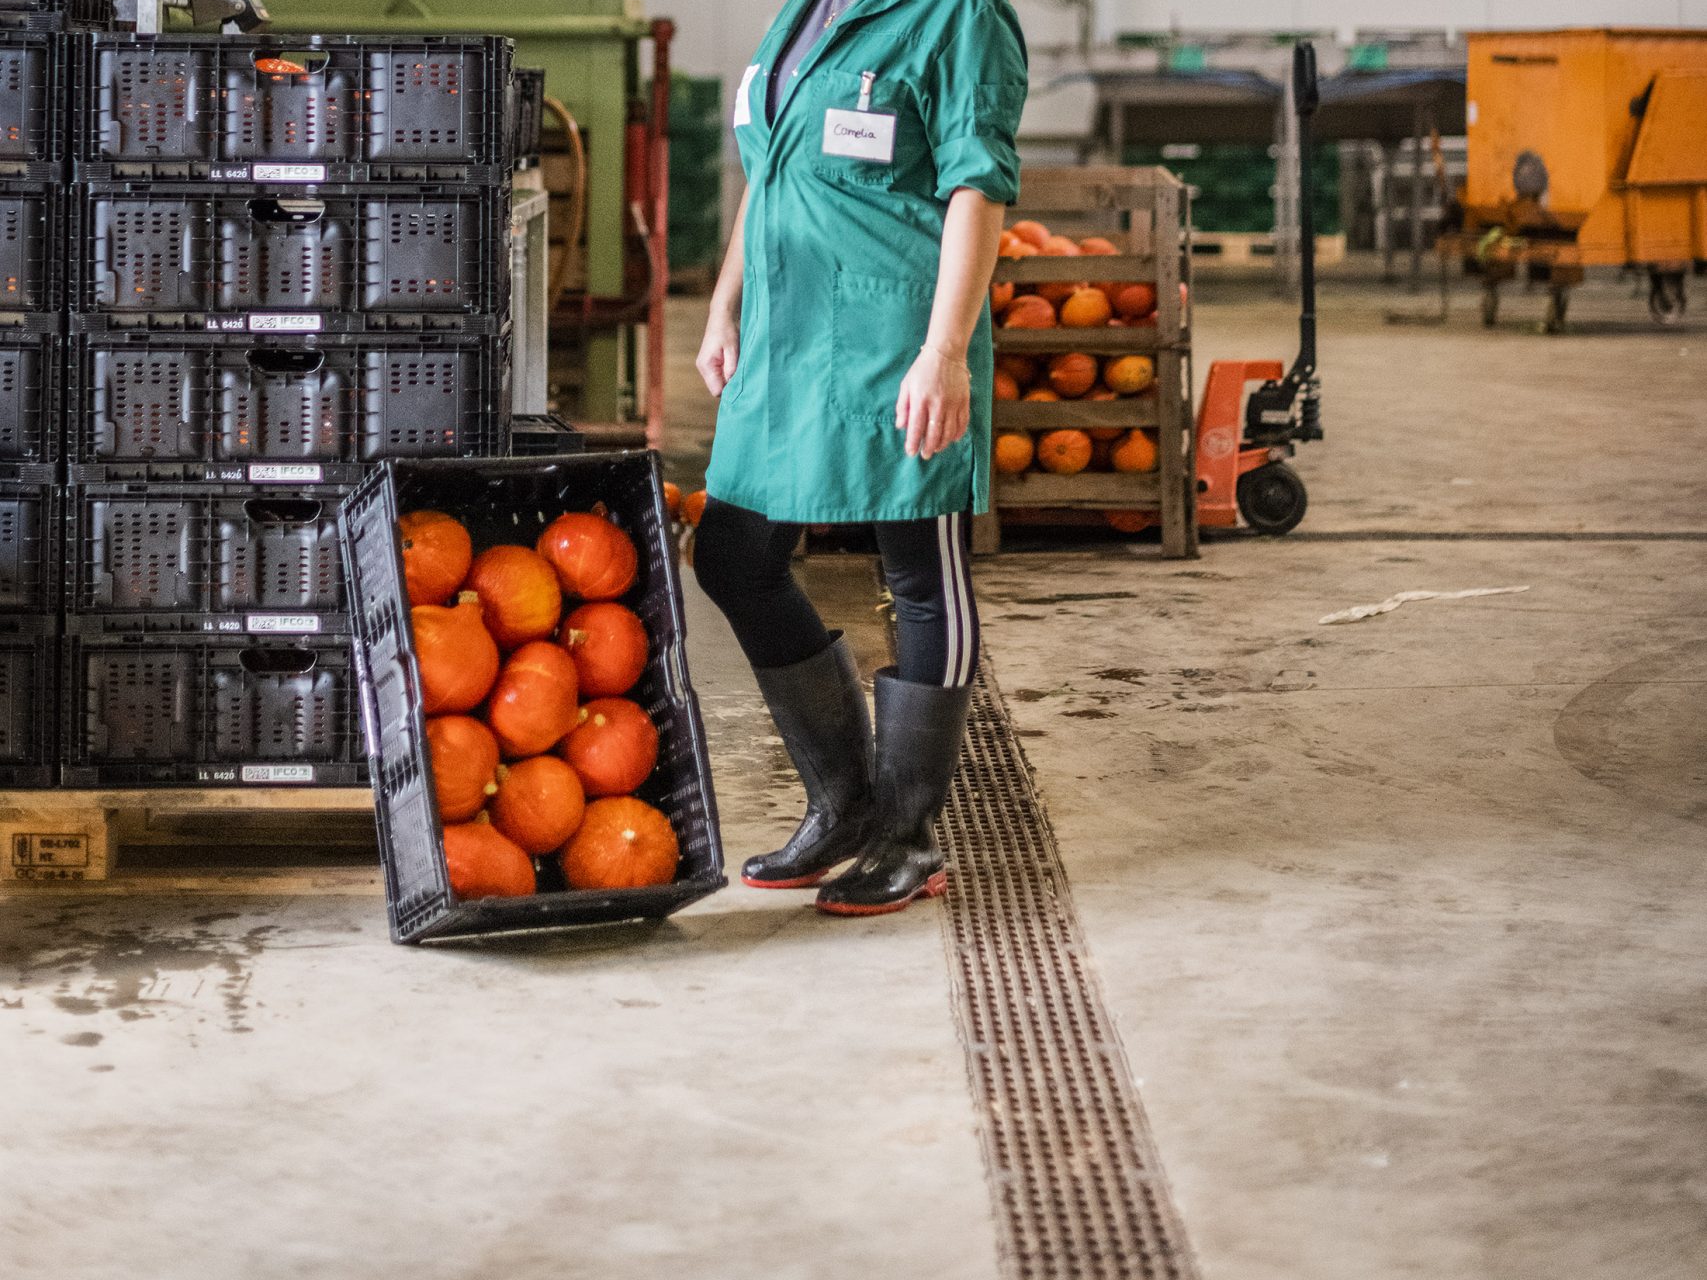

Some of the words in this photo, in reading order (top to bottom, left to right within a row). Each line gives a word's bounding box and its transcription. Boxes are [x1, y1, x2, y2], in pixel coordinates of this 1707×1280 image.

[833, 123, 877, 140] Camelia
[226, 169, 248, 178] 6420
[284, 167, 308, 175] IFCO
[222, 320, 244, 329] 6420
[280, 316, 304, 324] IFCO
[280, 466, 304, 474] IFCO
[219, 621, 240, 630] 6420
[279, 618, 303, 626] IFCO
[214, 771, 235, 780] 6420
[273, 767, 297, 776] IFCO
